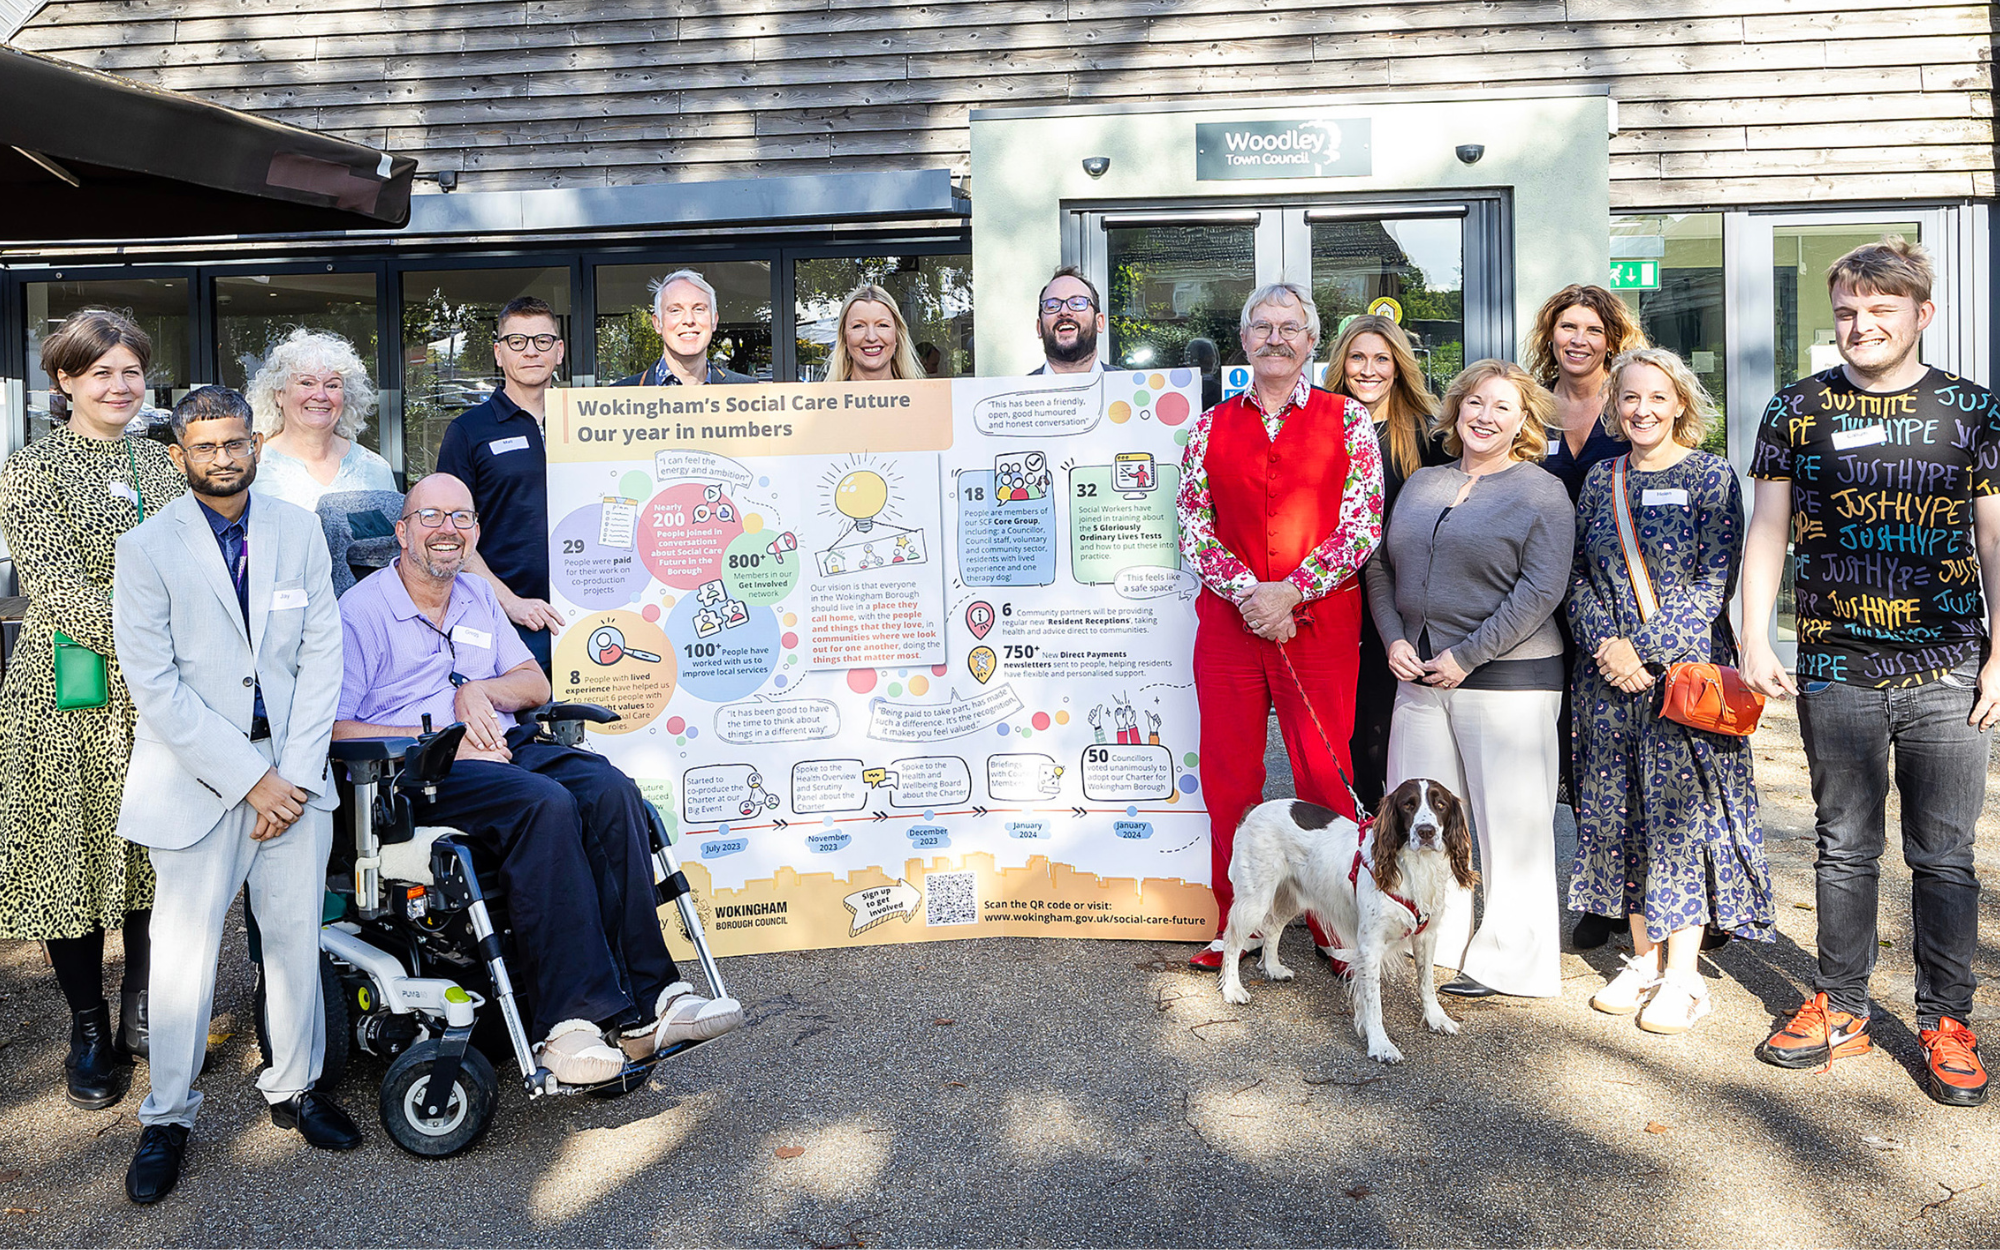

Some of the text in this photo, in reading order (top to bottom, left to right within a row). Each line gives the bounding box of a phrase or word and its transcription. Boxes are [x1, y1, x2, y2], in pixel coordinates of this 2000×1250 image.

[1224, 130, 1325, 154] Woodley
[1224, 152, 1310, 166] Town Council
[577, 394, 911, 419] Wokingham's Social Care Future
[987, 400, 1007, 408] "This
[1008, 400, 1023, 408] has
[1024, 399, 1045, 407] been
[1053, 398, 1086, 408] friendly,
[988, 408, 1077, 420] open, good humoured
[1005, 420, 1033, 428] honest
[1035, 418, 1089, 426] conversation"
[577, 421, 793, 445] Our year in numbers
[1836, 454, 1960, 494] JUSTHYPE
[965, 487, 984, 501] 18
[1077, 484, 1097, 497] 32
[654, 504, 682, 512] Nearly
[965, 509, 990, 518] People
[1830, 488, 1966, 528] JUSTHYPE
[653, 512, 685, 527] 200
[657, 528, 722, 539] People joined in
[1080, 533, 1117, 542] Ordinary
[658, 538, 717, 546] conversations
[1840, 524, 1964, 556] JUSTHYPE
[563, 539, 585, 554] 29
[564, 558, 591, 567] People
[613, 556, 632, 565] paid
[579, 567, 598, 575] their
[599, 566, 618, 574] work
[667, 567, 702, 577] Borough
[734, 572, 769, 580] Members
[1820, 552, 1931, 598] JUSTHYPE
[572, 576, 625, 587] co-production
[754, 580, 788, 588] Involved
[584, 586, 614, 596] projects
[1827, 590, 1921, 630] JUSTHYPE
[812, 633, 870, 642] communities
[872, 631, 900, 640] where
[916, 630, 936, 638] look
[722, 647, 749, 657] People
[750, 646, 769, 654] have
[1087, 651, 1127, 660] Payments
[692, 659, 722, 667] worked
[570, 670, 650, 685] 8 People with lived
[683, 666, 768, 679] improve local services
[565, 685, 610, 695] experience
[612, 683, 630, 691] have
[632, 682, 658, 692] helped
[1088, 749, 1109, 763] 50
[1110, 764, 1157, 773] unanimously
[1087, 774, 1109, 782] adopt
[1087, 783, 1166, 792] Wokingham Borough
[909, 828, 948, 836] December
[1012, 822, 1043, 831] January
[1116, 822, 1147, 831] January
[808, 834, 848, 842] November
[920, 838, 938, 846] 2023
[705, 842, 741, 854] July 2023
[819, 844, 838, 852] 2023
[862, 888, 891, 900] Sign up
[877, 897, 890, 906] get
[984, 901, 1008, 909] Scan
[1010, 901, 1028, 909] the
[1029, 901, 1045, 911] QR
[1047, 901, 1071, 910] code
[1086, 901, 1111, 910] visit:
[715, 902, 788, 918] WOKINGHAM
[869, 902, 903, 917] involved
[716, 917, 788, 930] BOROUGH COUNCIL
[984, 912, 1205, 926] www.wokingham.gov.uk/social-care-future
